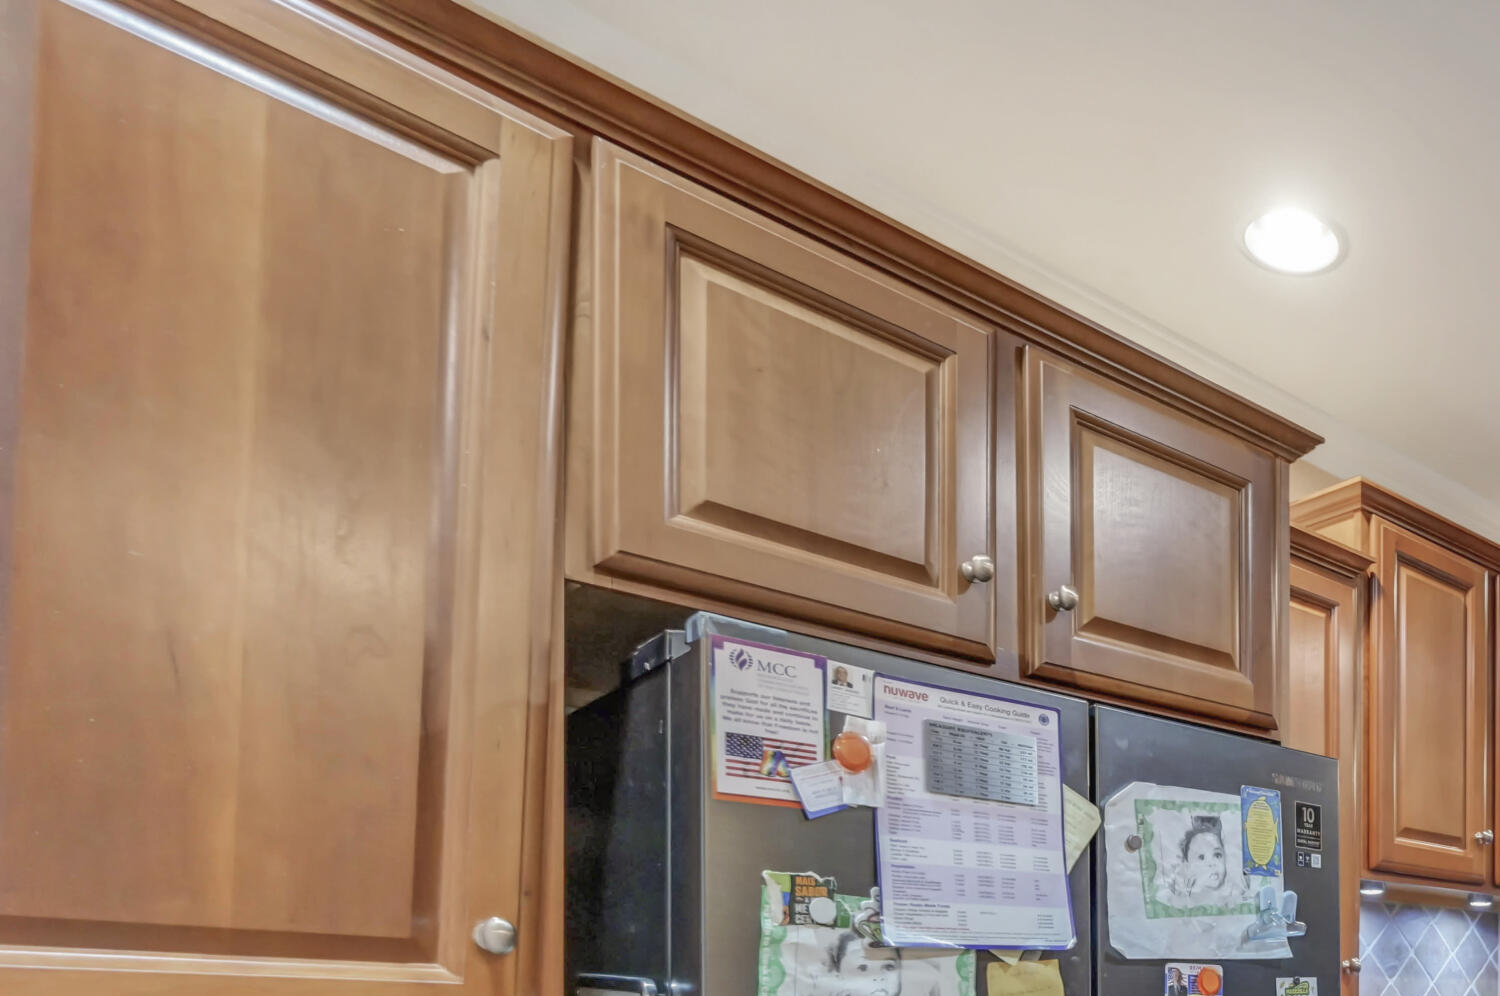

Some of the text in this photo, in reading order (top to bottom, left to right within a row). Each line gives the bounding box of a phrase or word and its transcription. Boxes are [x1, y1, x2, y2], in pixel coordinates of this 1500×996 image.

[757, 660, 797, 678] MCC
[883, 684, 929, 702] nuwave
[939, 697, 960, 707] Quick
[967, 702, 983, 711] Easy
[984, 704, 1011, 716] Cooking
[1012, 709, 1031, 719] Guide
[1302, 807, 1315, 823] 10
[1296, 828, 1321, 836] WARRANTY
